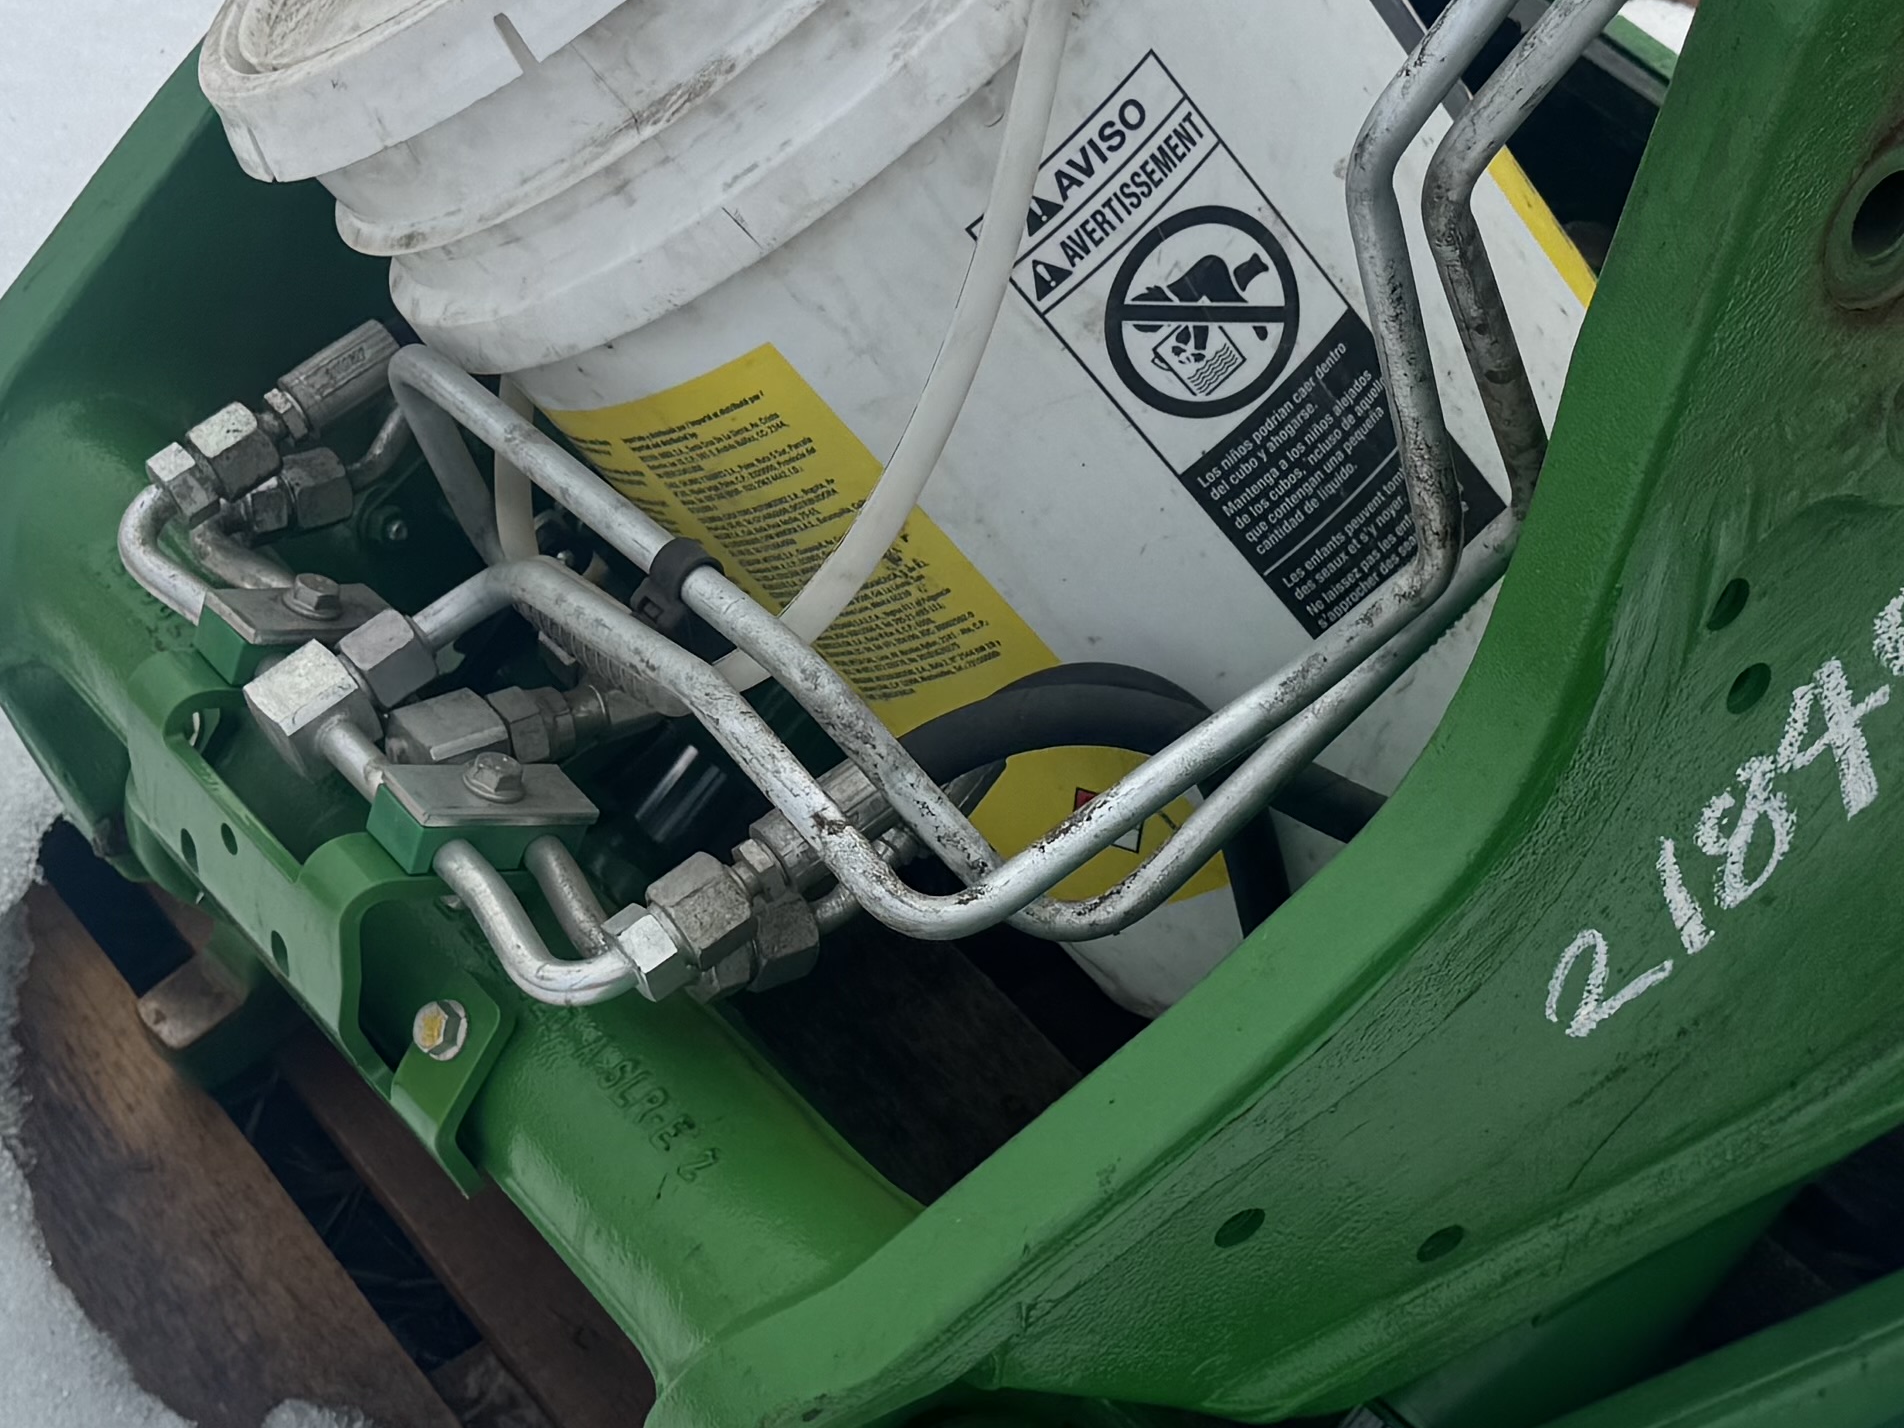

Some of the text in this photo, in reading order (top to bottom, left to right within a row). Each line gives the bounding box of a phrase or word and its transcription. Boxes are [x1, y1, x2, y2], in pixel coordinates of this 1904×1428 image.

[1054, 98, 1146, 203] AVISO
[1059, 111, 1204, 268] AVERTISSEMENT
[1196, 466, 1222, 488] Los
[1220, 439, 1254, 471] niños
[1292, 376, 1316, 404] caer
[1315, 342, 1347, 381] dentro
[1210, 403, 1319, 501] del cubo y ahogarse.
[1221, 370, 1372, 517] Mantenga a los niños alejados
[1234, 513, 1251, 530] de
[1248, 498, 1270, 517] los
[1269, 468, 1307, 501] cubos,
[1302, 428, 1343, 466] ncluso
[1341, 413, 1356, 431] de
[1245, 406, 1385, 543] que contengan una pequeña
[1256, 509, 1305, 555] cantidad
[1303, 497, 1320, 515] de
[1282, 567, 1306, 588] Les
[1304, 532, 1346, 571] enfants
[1344, 491, 1386, 537] peuvent
[1294, 579, 1317, 601] des
[1315, 551, 1349, 583] seaux
[1347, 538, 1361, 555] et
[1305, 599, 1325, 616] Ne
[1321, 567, 1362, 604] laissez
[1360, 549, 1381, 573] pas
[1377, 533, 1397, 553] les
[1379, 553, 1400, 575] des
